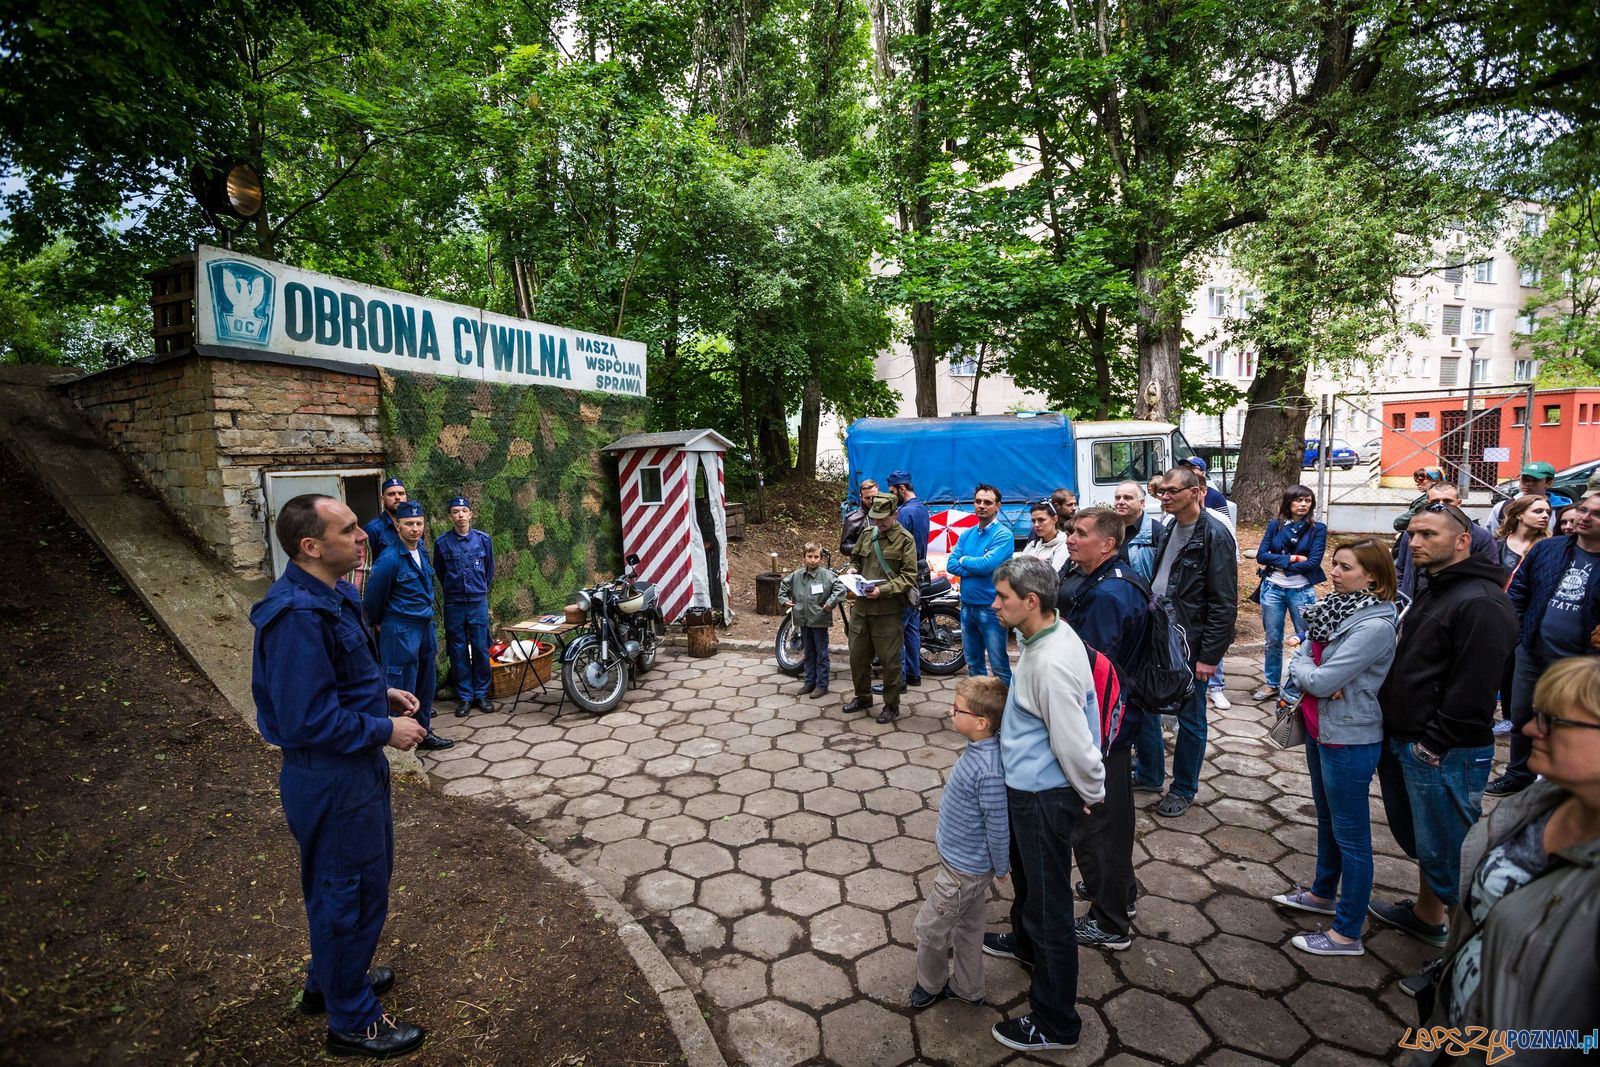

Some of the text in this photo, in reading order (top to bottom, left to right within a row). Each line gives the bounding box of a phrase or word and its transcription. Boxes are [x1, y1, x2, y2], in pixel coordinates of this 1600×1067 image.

[233, 319, 255, 333] OC
[284, 281, 572, 381] OBRONA CYWILNA
[575, 336, 618, 359] NASZA
[596, 374, 642, 395] SPRAWA
